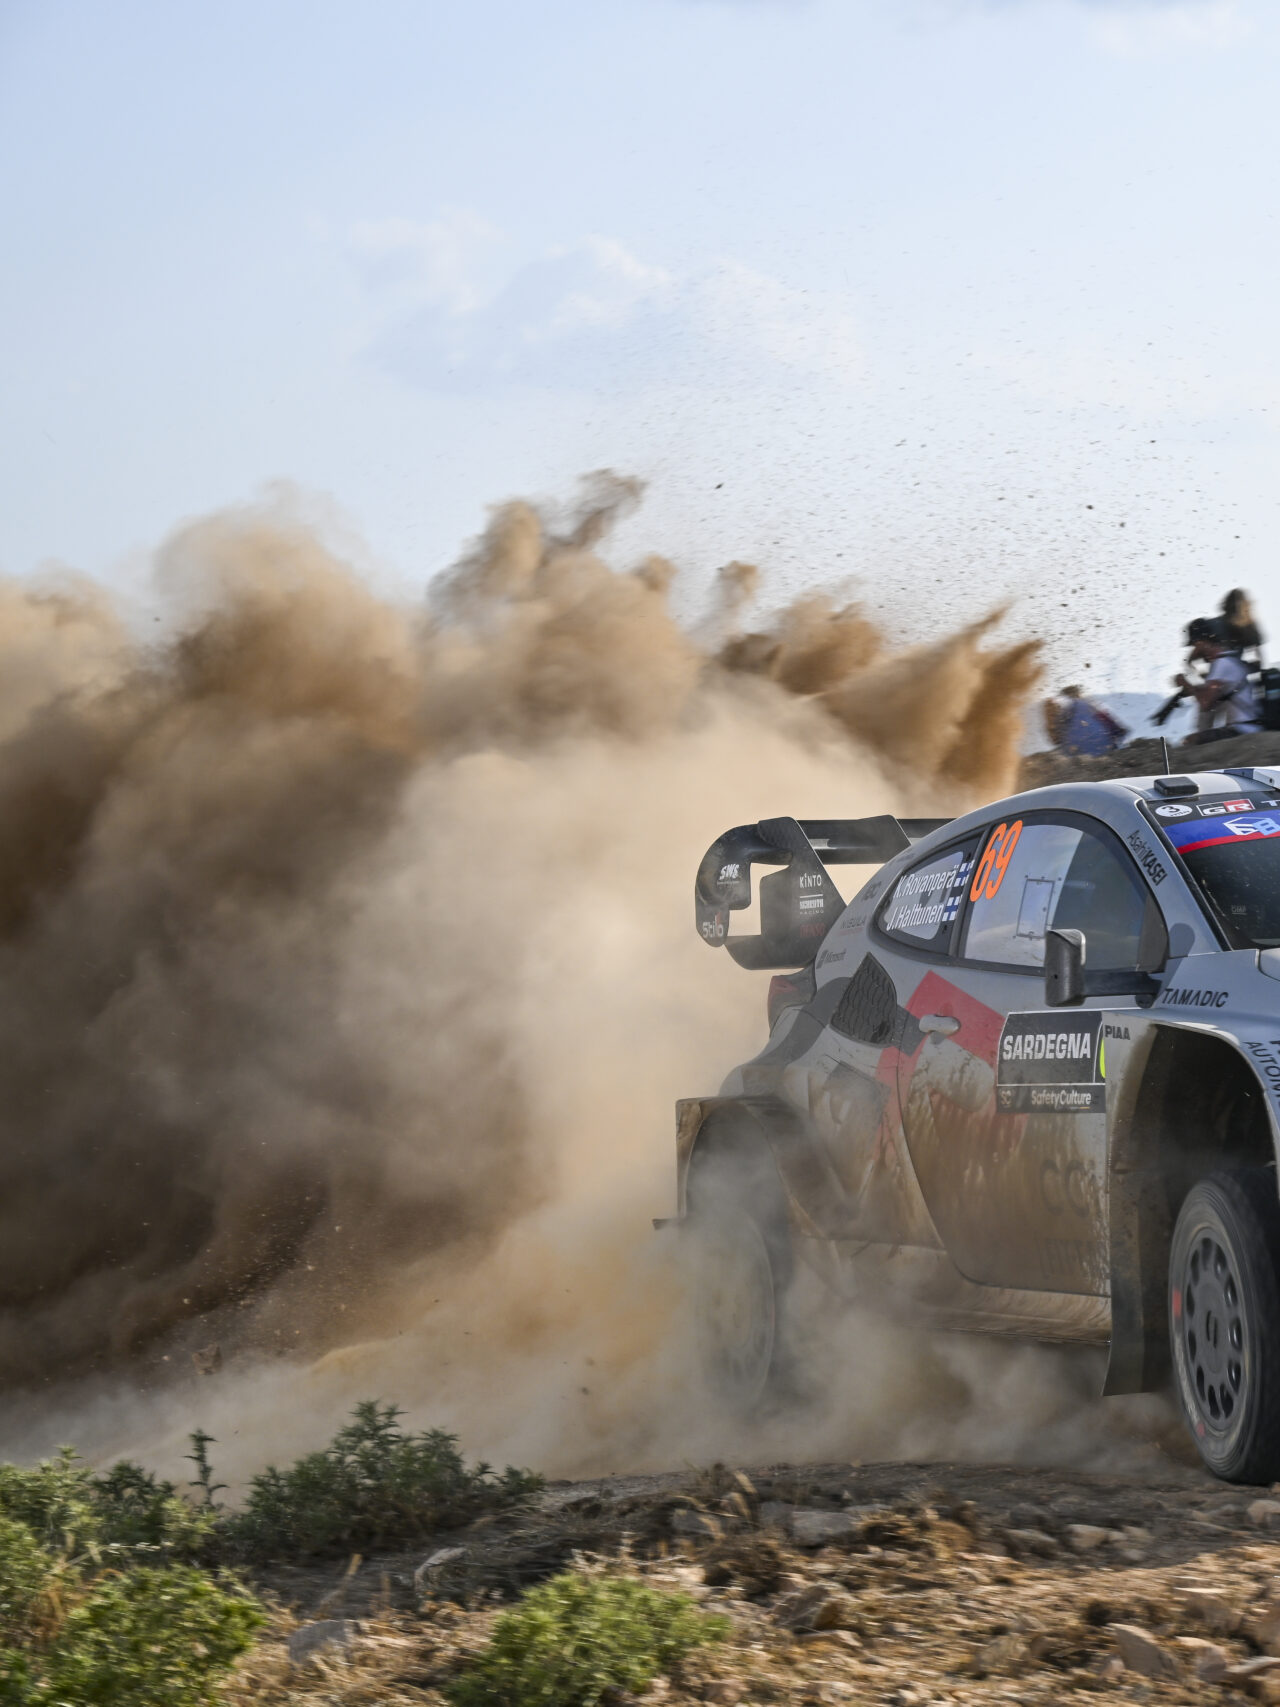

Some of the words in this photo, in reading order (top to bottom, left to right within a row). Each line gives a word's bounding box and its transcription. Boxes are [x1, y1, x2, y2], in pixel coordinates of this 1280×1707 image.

[1202, 802, 1253, 815] GR
[970, 819, 1023, 902] 69
[1162, 988, 1230, 1008] TAMADIC
[1104, 1025, 1131, 1040] PIAA
[1002, 1032, 1091, 1060] SARDEGNA
[1031, 1089, 1092, 1106] SafetyCulture
